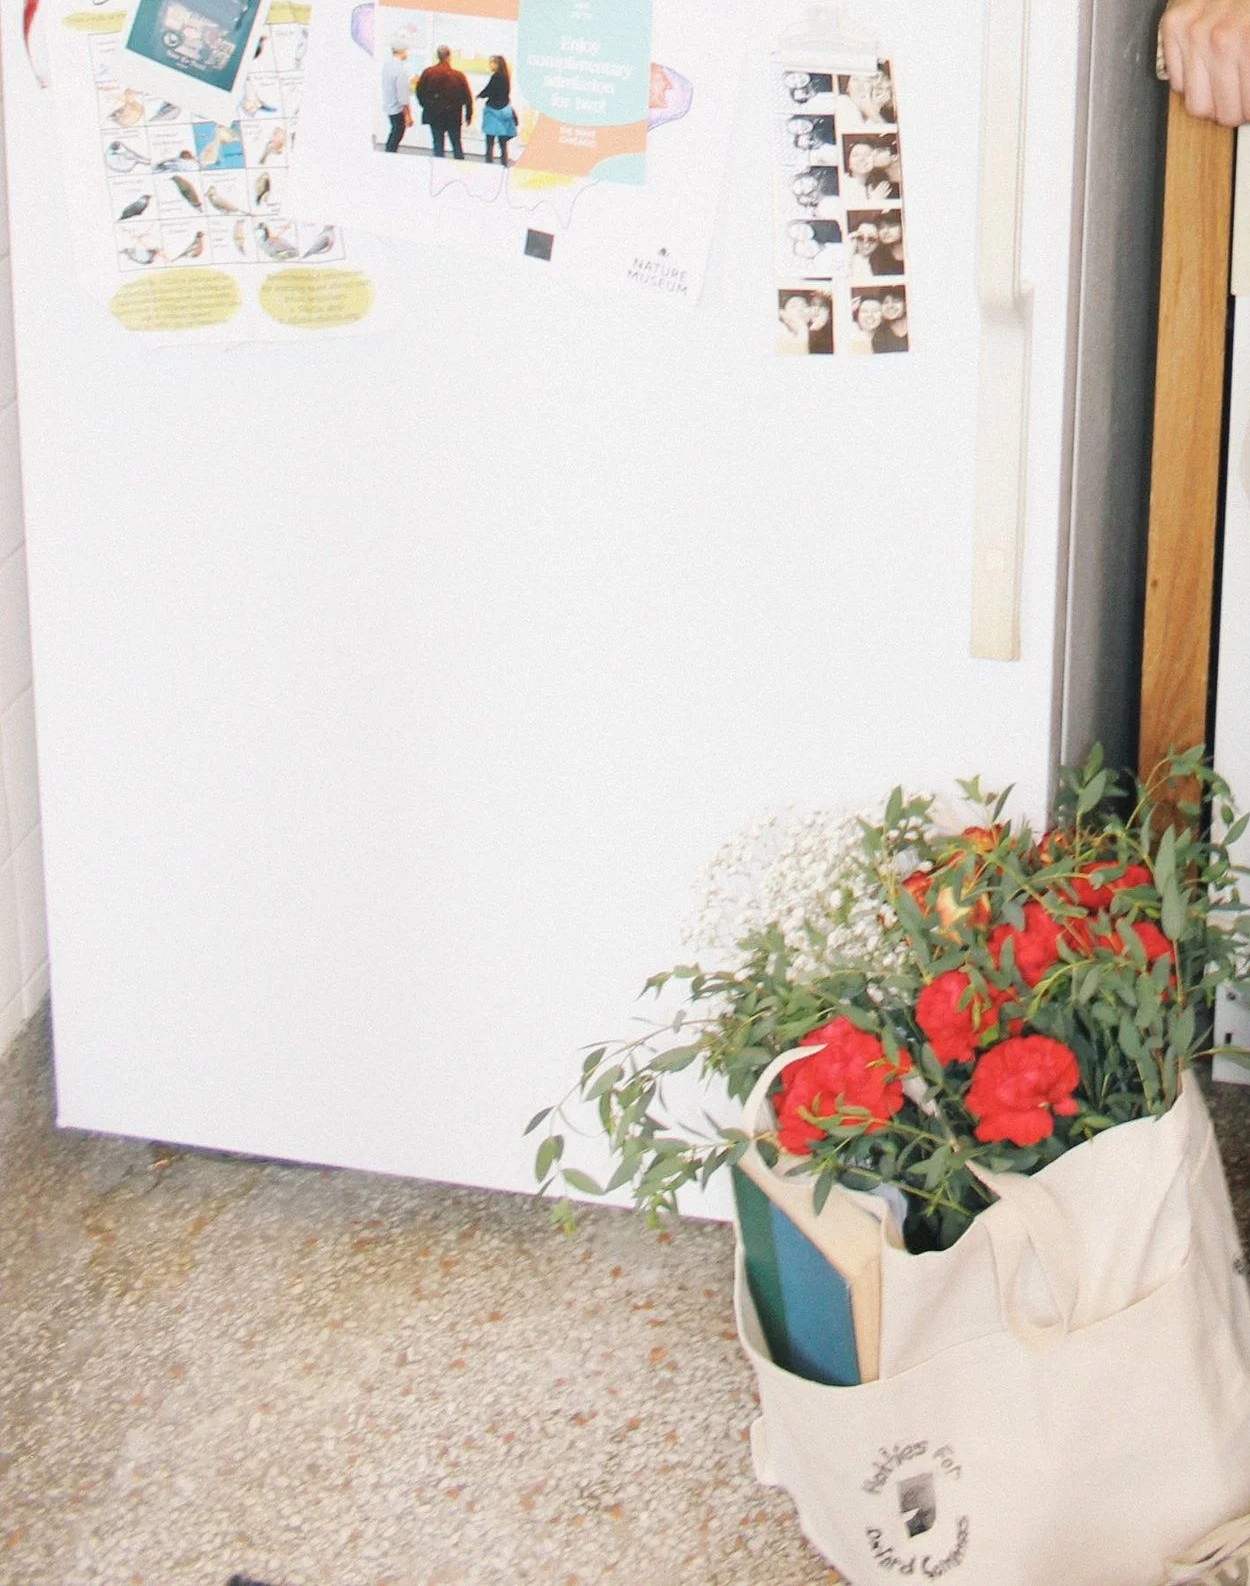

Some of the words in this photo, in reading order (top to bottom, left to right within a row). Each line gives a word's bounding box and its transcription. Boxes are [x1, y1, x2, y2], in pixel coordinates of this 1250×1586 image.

[559, 35, 600, 56] Enjoy
[526, 54, 633, 82] complimentary
[626, 269, 689, 296] MUSEUM
[632, 257, 688, 282] NATURE
